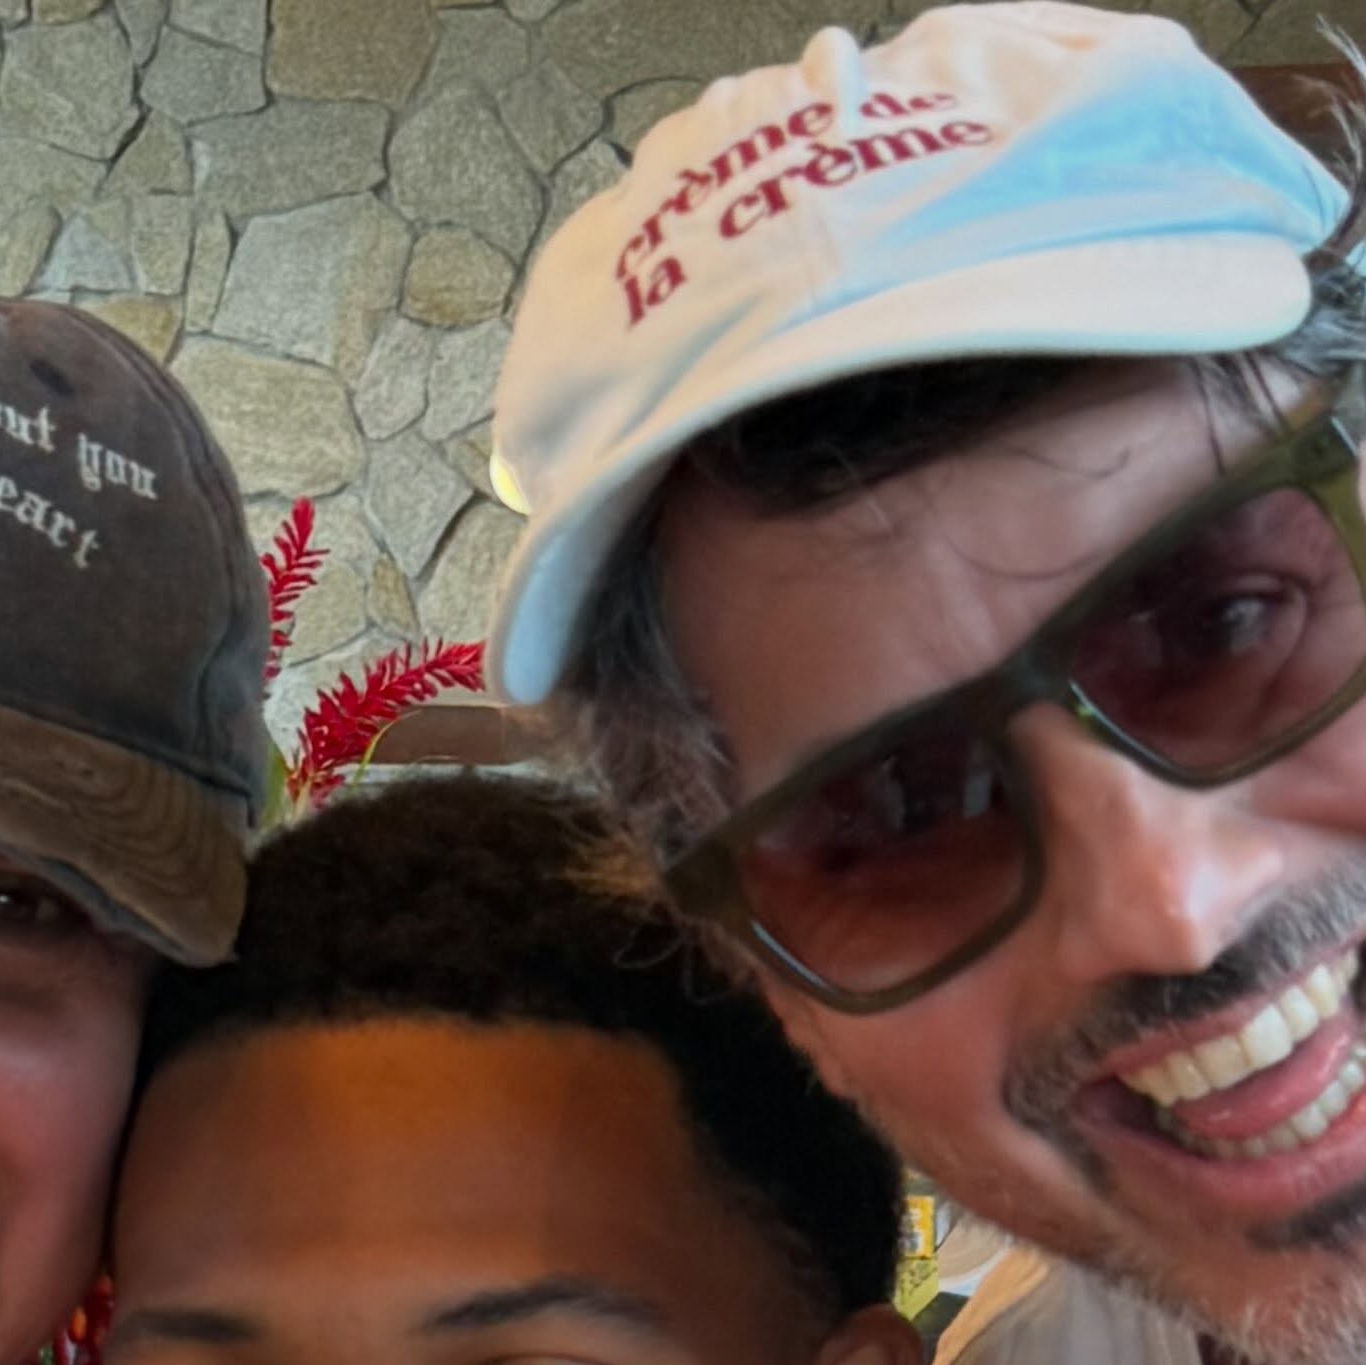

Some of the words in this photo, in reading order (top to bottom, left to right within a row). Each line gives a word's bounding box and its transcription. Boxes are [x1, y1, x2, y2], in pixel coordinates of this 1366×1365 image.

[615, 102, 833, 281] crème
[858, 91, 959, 121] de
[622, 255, 688, 332] la
[717, 120, 993, 241] crème
[77, 431, 159, 500] you
